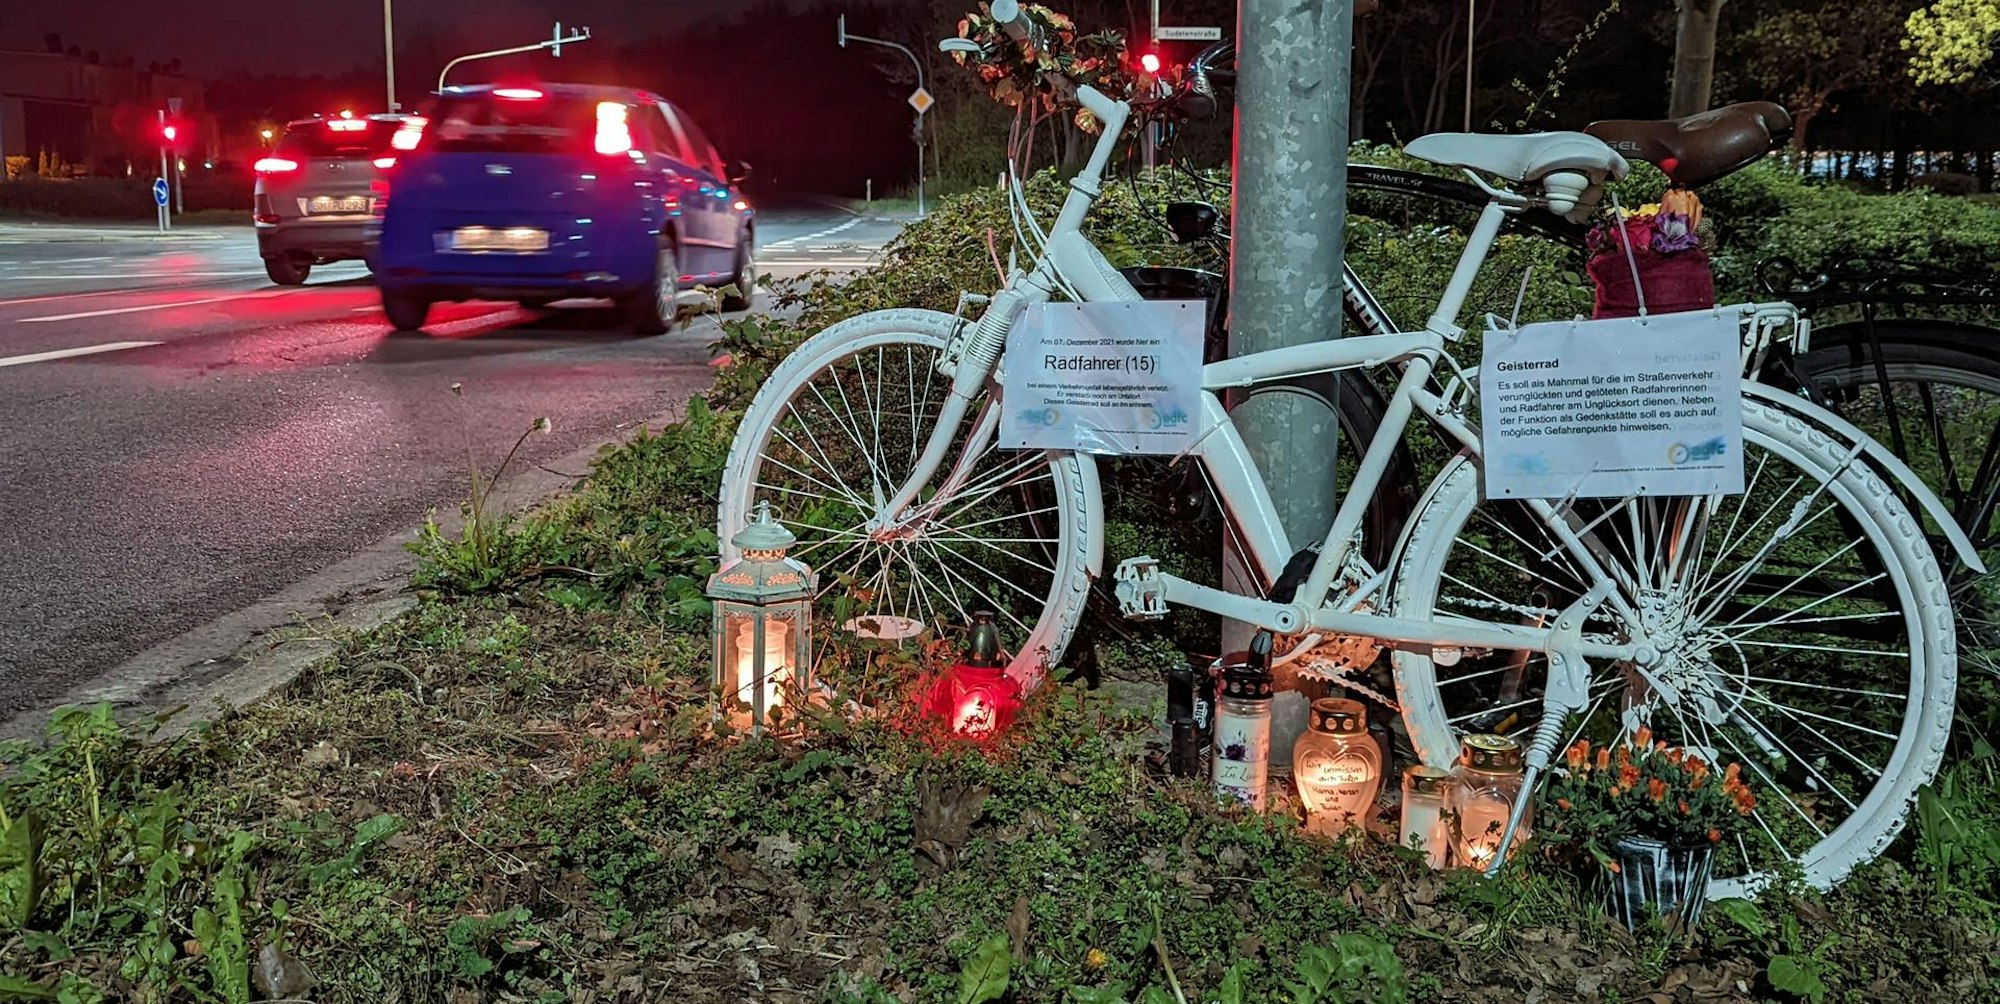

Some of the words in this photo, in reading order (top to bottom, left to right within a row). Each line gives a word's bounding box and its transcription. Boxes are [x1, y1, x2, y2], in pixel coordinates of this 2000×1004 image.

[1067, 338, 1098, 347] Dezember
[1099, 338, 1114, 346] 2021
[1115, 338, 1135, 347] wurde
[1149, 338, 1161, 346] ein
[1044, 354, 1122, 372] Radfahrer
[1125, 354, 1155, 375] (15)
[1497, 358, 1559, 372] Geisterrad
[1498, 381, 1511, 391] Es
[1513, 380, 1529, 390] soll
[1531, 379, 1546, 389] als
[1547, 376, 1590, 388] Mahnmal
[1591, 375, 1605, 385] für
[1606, 374, 1621, 384] die
[1623, 374, 1635, 383] im
[1637, 370, 1714, 383] Straßenverkehr
[1498, 390, 1563, 403] verunglückten
[1565, 389, 1583, 399] und
[1584, 386, 1628, 399] getöteten
[1630, 383, 1707, 395] Radfahrerinnen
[1500, 404, 1517, 414] und
[1519, 401, 1566, 413] Radfahrer
[1567, 401, 1583, 411] am
[1584, 397, 1640, 411] Unglücksort
[1642, 396, 1679, 407] dienen.
[1681, 395, 1714, 405] Neben
[1500, 416, 1516, 426] der
[1518, 414, 1557, 425] Funktion
[1559, 413, 1573, 423] als
[1575, 409, 1637, 422] Gedenkstätte
[1639, 409, 1657, 419] soll
[1659, 410, 1671, 419] es
[1673, 407, 1698, 418] auch
[1700, 405, 1717, 417] auf
[1500, 427, 1542, 439] mögliche
[1544, 423, 1618, 437] Gefahrenpunkte
[1620, 421, 1672, 433] hinweisen.
